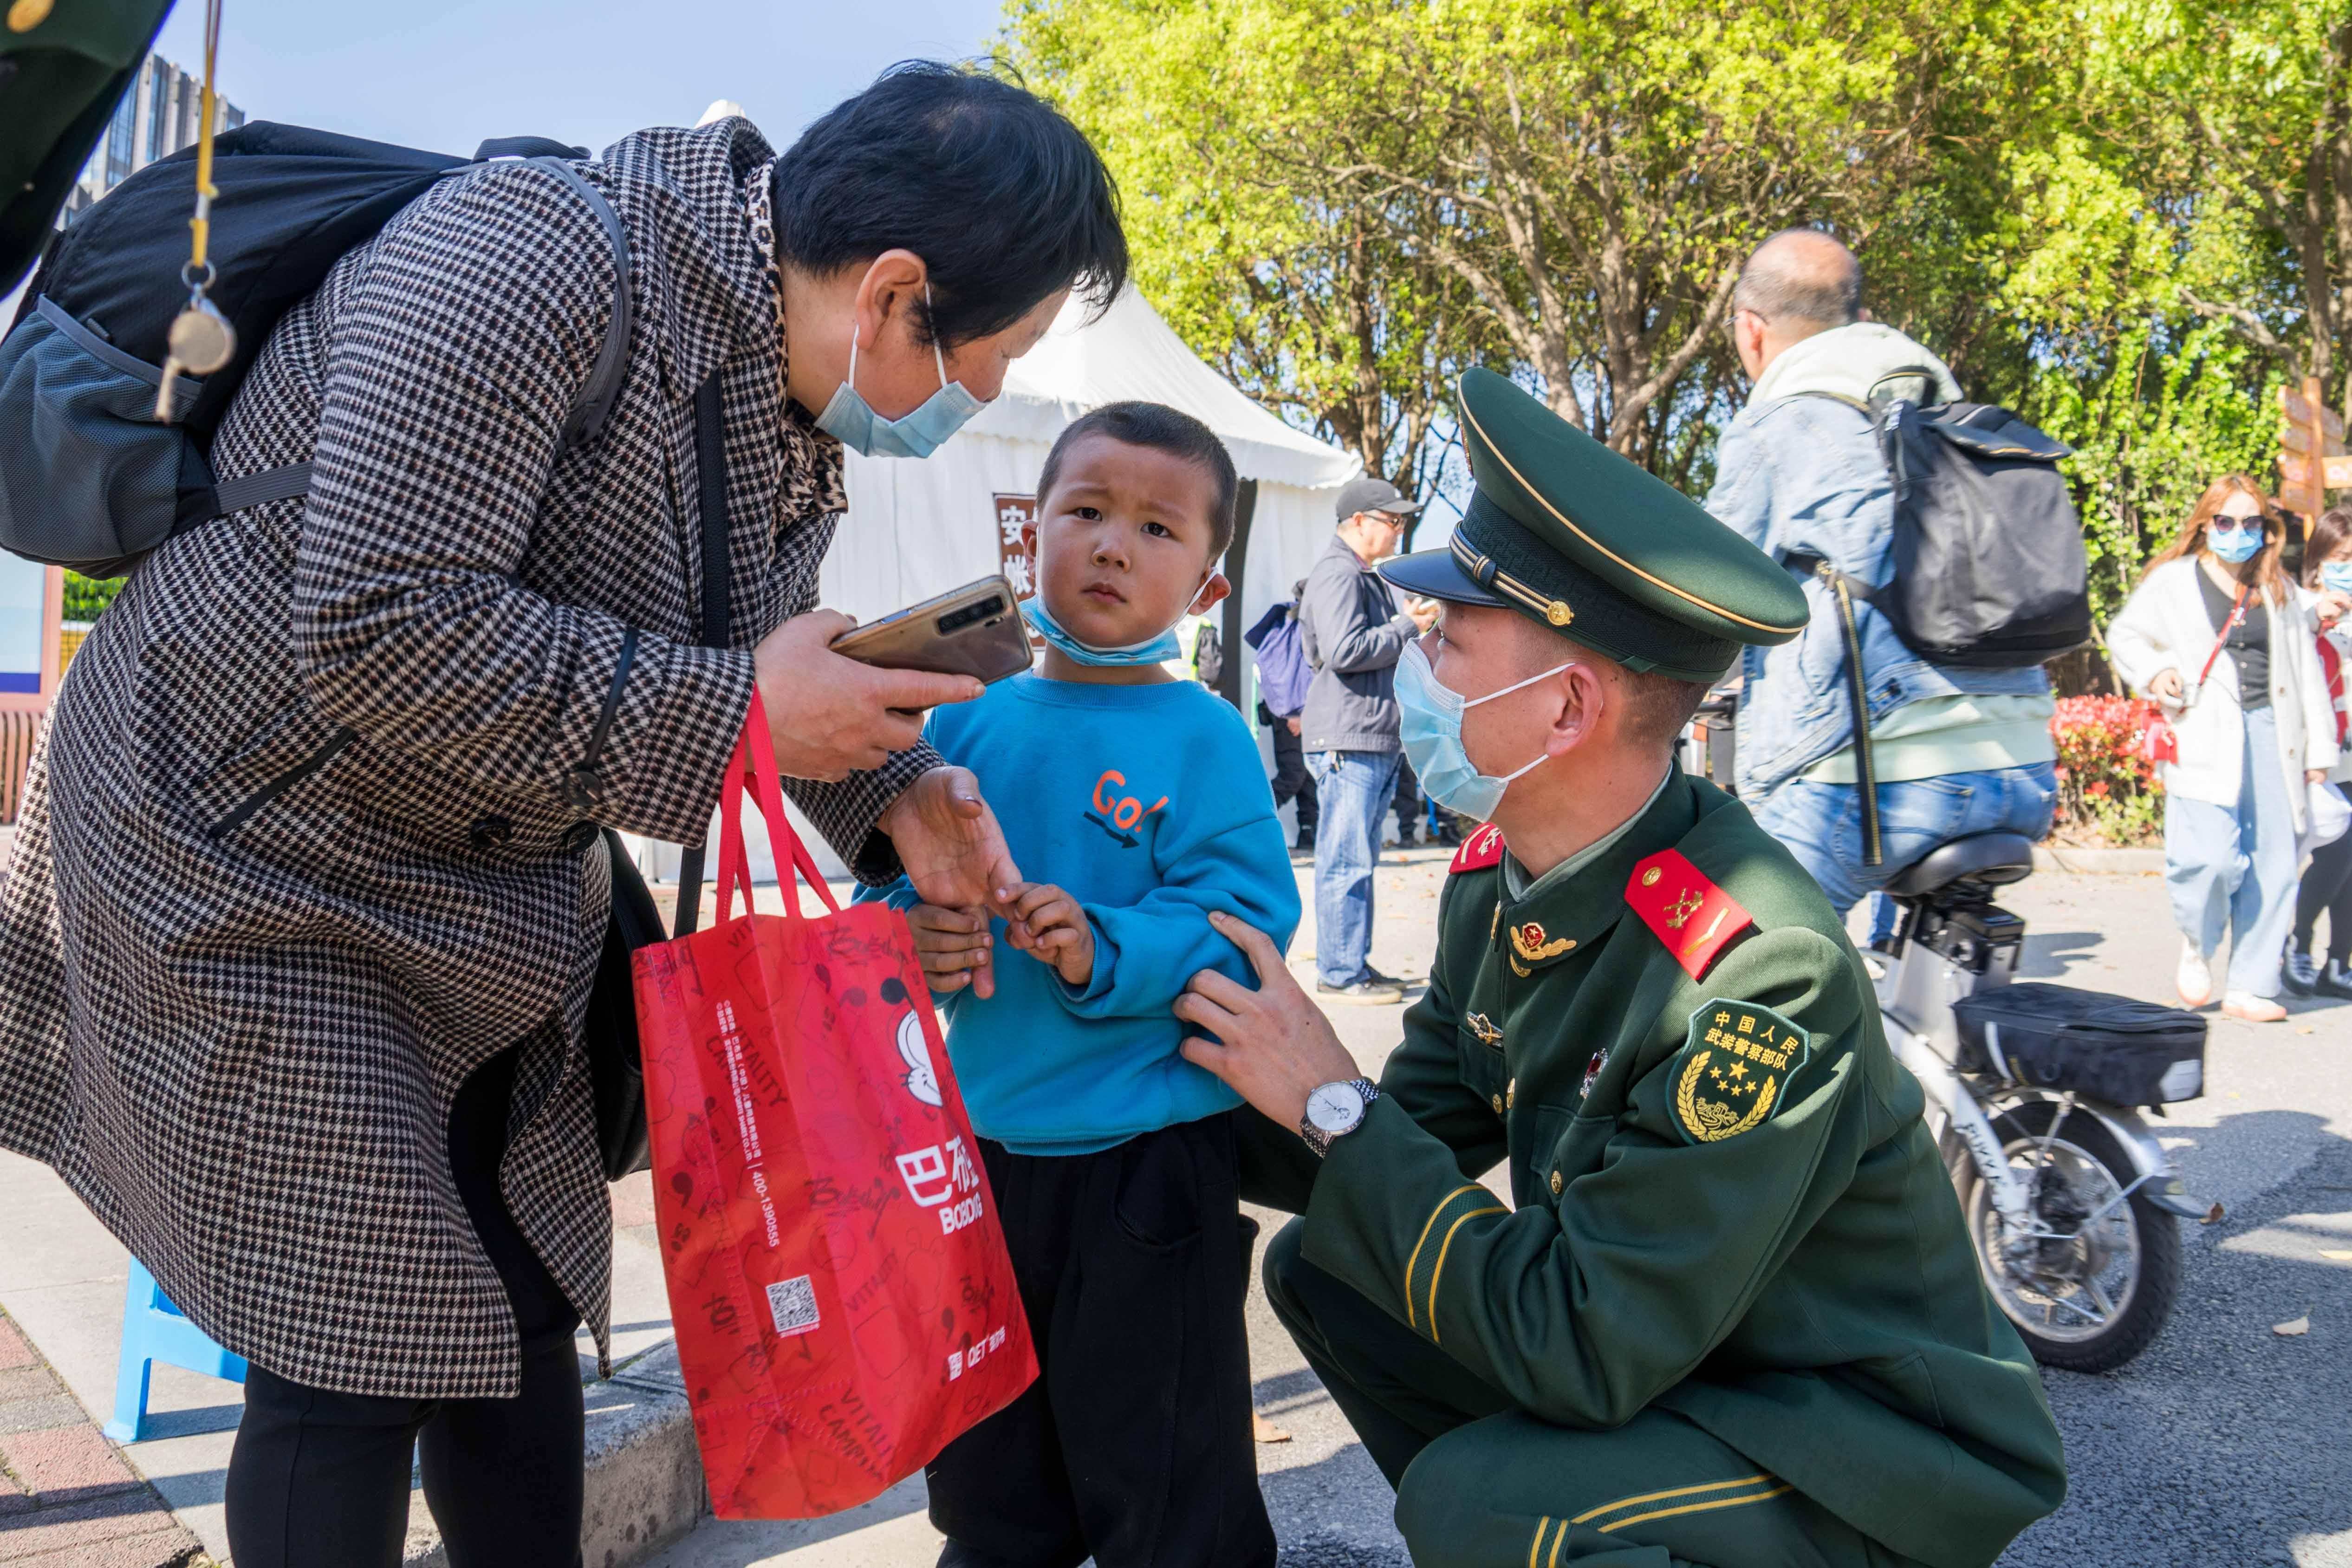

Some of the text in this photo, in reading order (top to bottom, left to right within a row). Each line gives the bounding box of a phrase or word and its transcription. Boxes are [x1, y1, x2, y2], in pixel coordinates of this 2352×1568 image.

[1001, 505, 1038, 545] 安
[1704, 1027, 1788, 1071] 武装警察部队
[1715, 1011, 1799, 1055] 中国人民
[752, 1171, 780, 1246] 400-1390555
